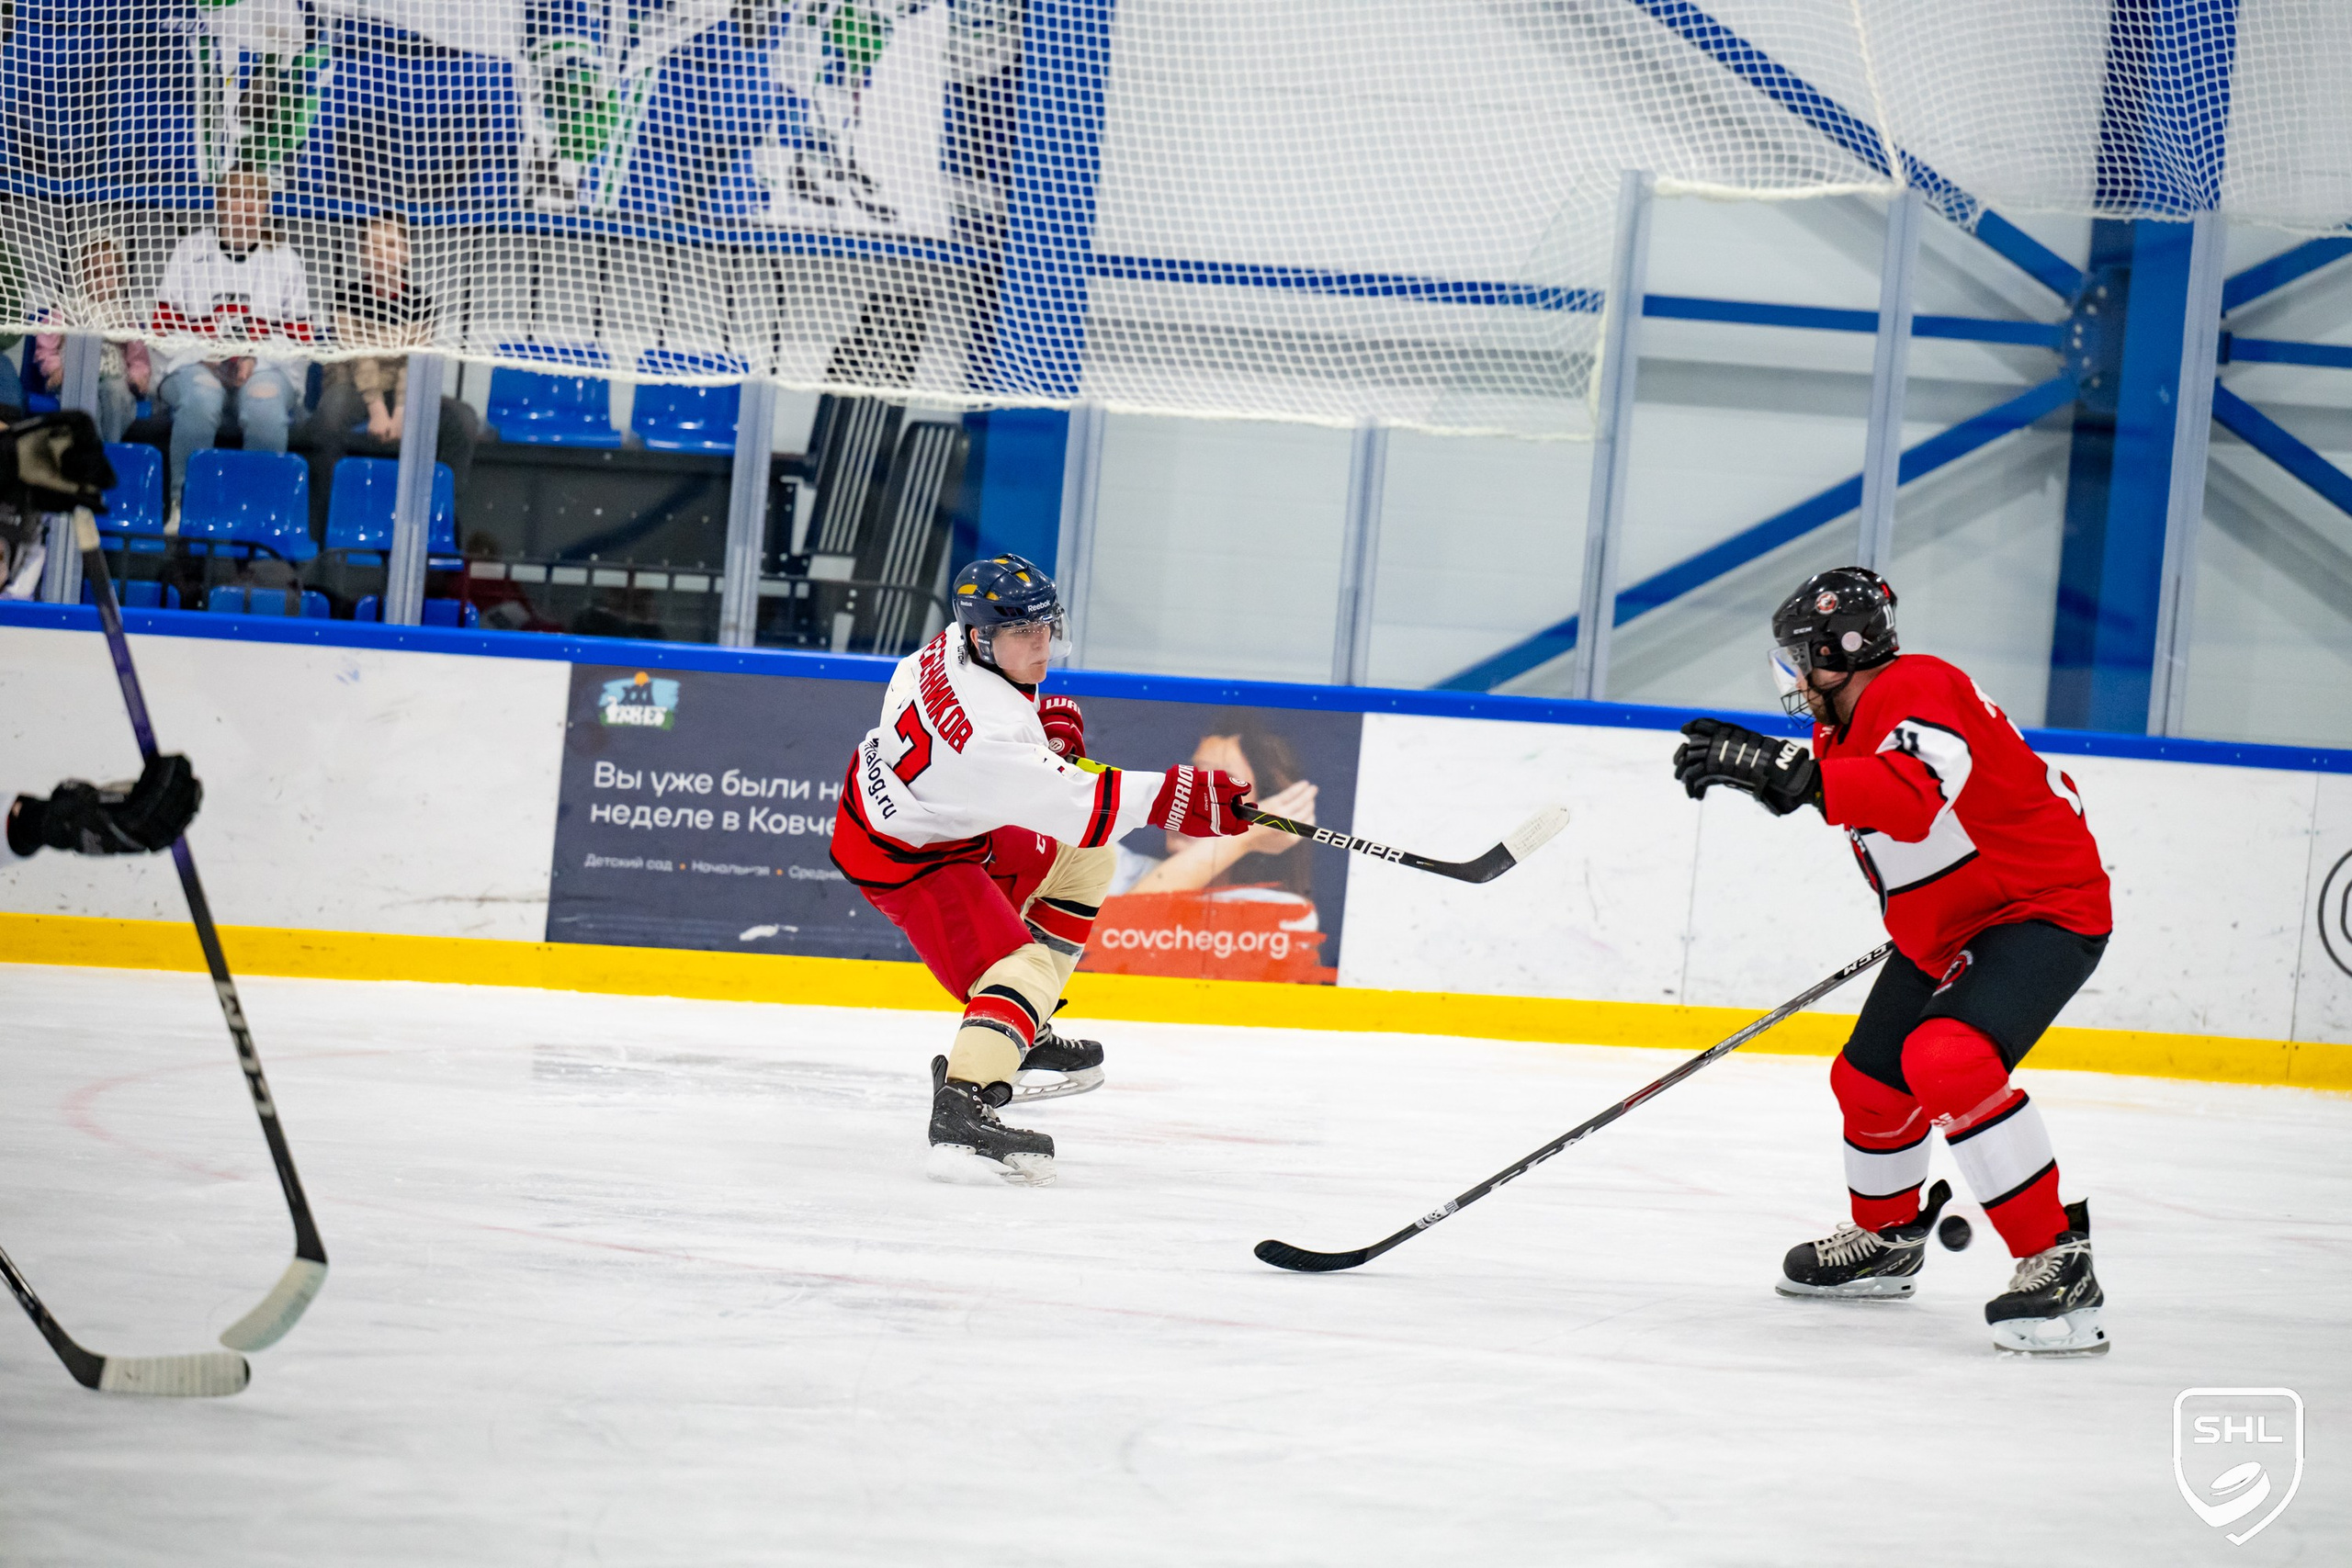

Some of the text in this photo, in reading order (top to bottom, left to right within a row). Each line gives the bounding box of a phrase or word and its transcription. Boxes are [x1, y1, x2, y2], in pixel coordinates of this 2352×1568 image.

[1027, 599, 1051, 613] Reebok
[1793, 626, 1813, 635] CCM
[894, 698, 933, 788] 7
[594, 761, 844, 802] Вы уже были н
[590, 803, 714, 830] неделе
[722, 810, 741, 831] в
[646, 858, 673, 873] сад
[1102, 923, 1290, 960] covcheg.org
[1843, 943, 1888, 976] CCM
[1875, 1252, 1912, 1277] CCM
[2066, 1269, 2093, 1309] CCM
